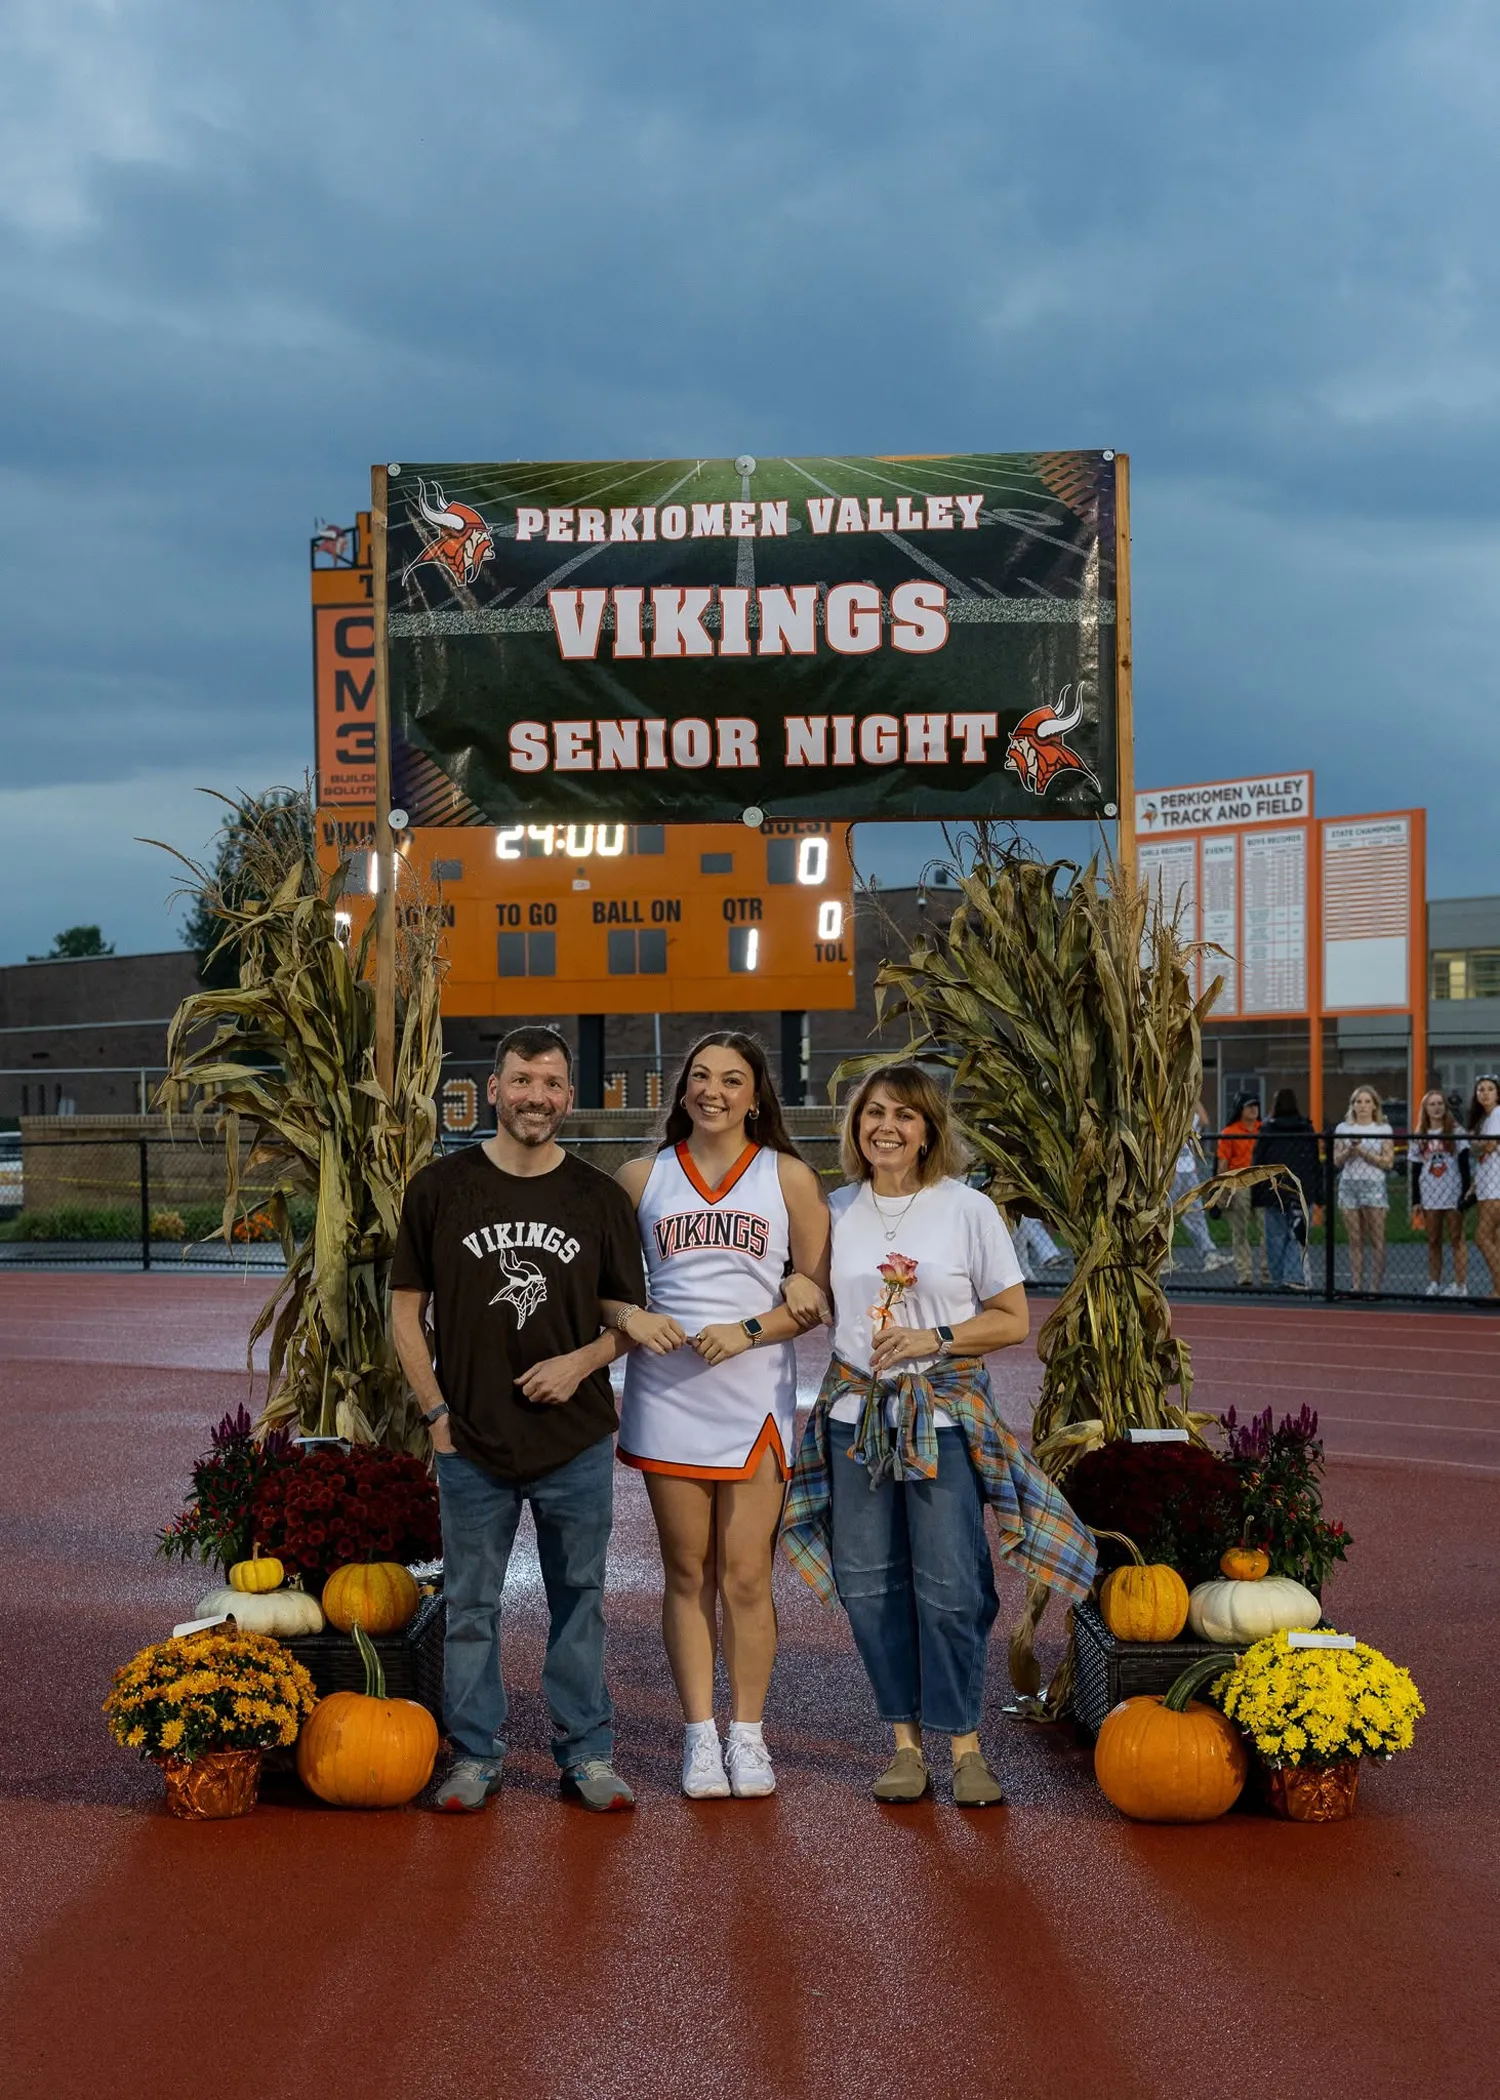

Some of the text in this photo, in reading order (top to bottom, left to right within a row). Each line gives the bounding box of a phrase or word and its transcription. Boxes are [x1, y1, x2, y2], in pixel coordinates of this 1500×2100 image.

[515, 494, 984, 542] PERKIOMEN VALLEY
[547, 580, 949, 660] VIKINGS
[507, 711, 999, 773] SENIOR NIGHT
[324, 786, 376, 795] SOLUTI
[330, 773, 376, 783] BUILDI
[1160, 779, 1304, 809] PERKIOMEN VALLEY
[1160, 797, 1304, 828] TRACK AND FIELD
[496, 824, 625, 859] 24:00
[797, 837, 828, 885] 0
[496, 902, 557, 926] TO GO
[592, 899, 681, 924] BALL ON
[723, 898, 763, 924] QTR
[818, 901, 842, 940] 0
[746, 928, 758, 971] 1
[814, 943, 848, 962] TOL
[462, 1221, 581, 1264] VIKINGS
[652, 1210, 769, 1262] VIKINGS
